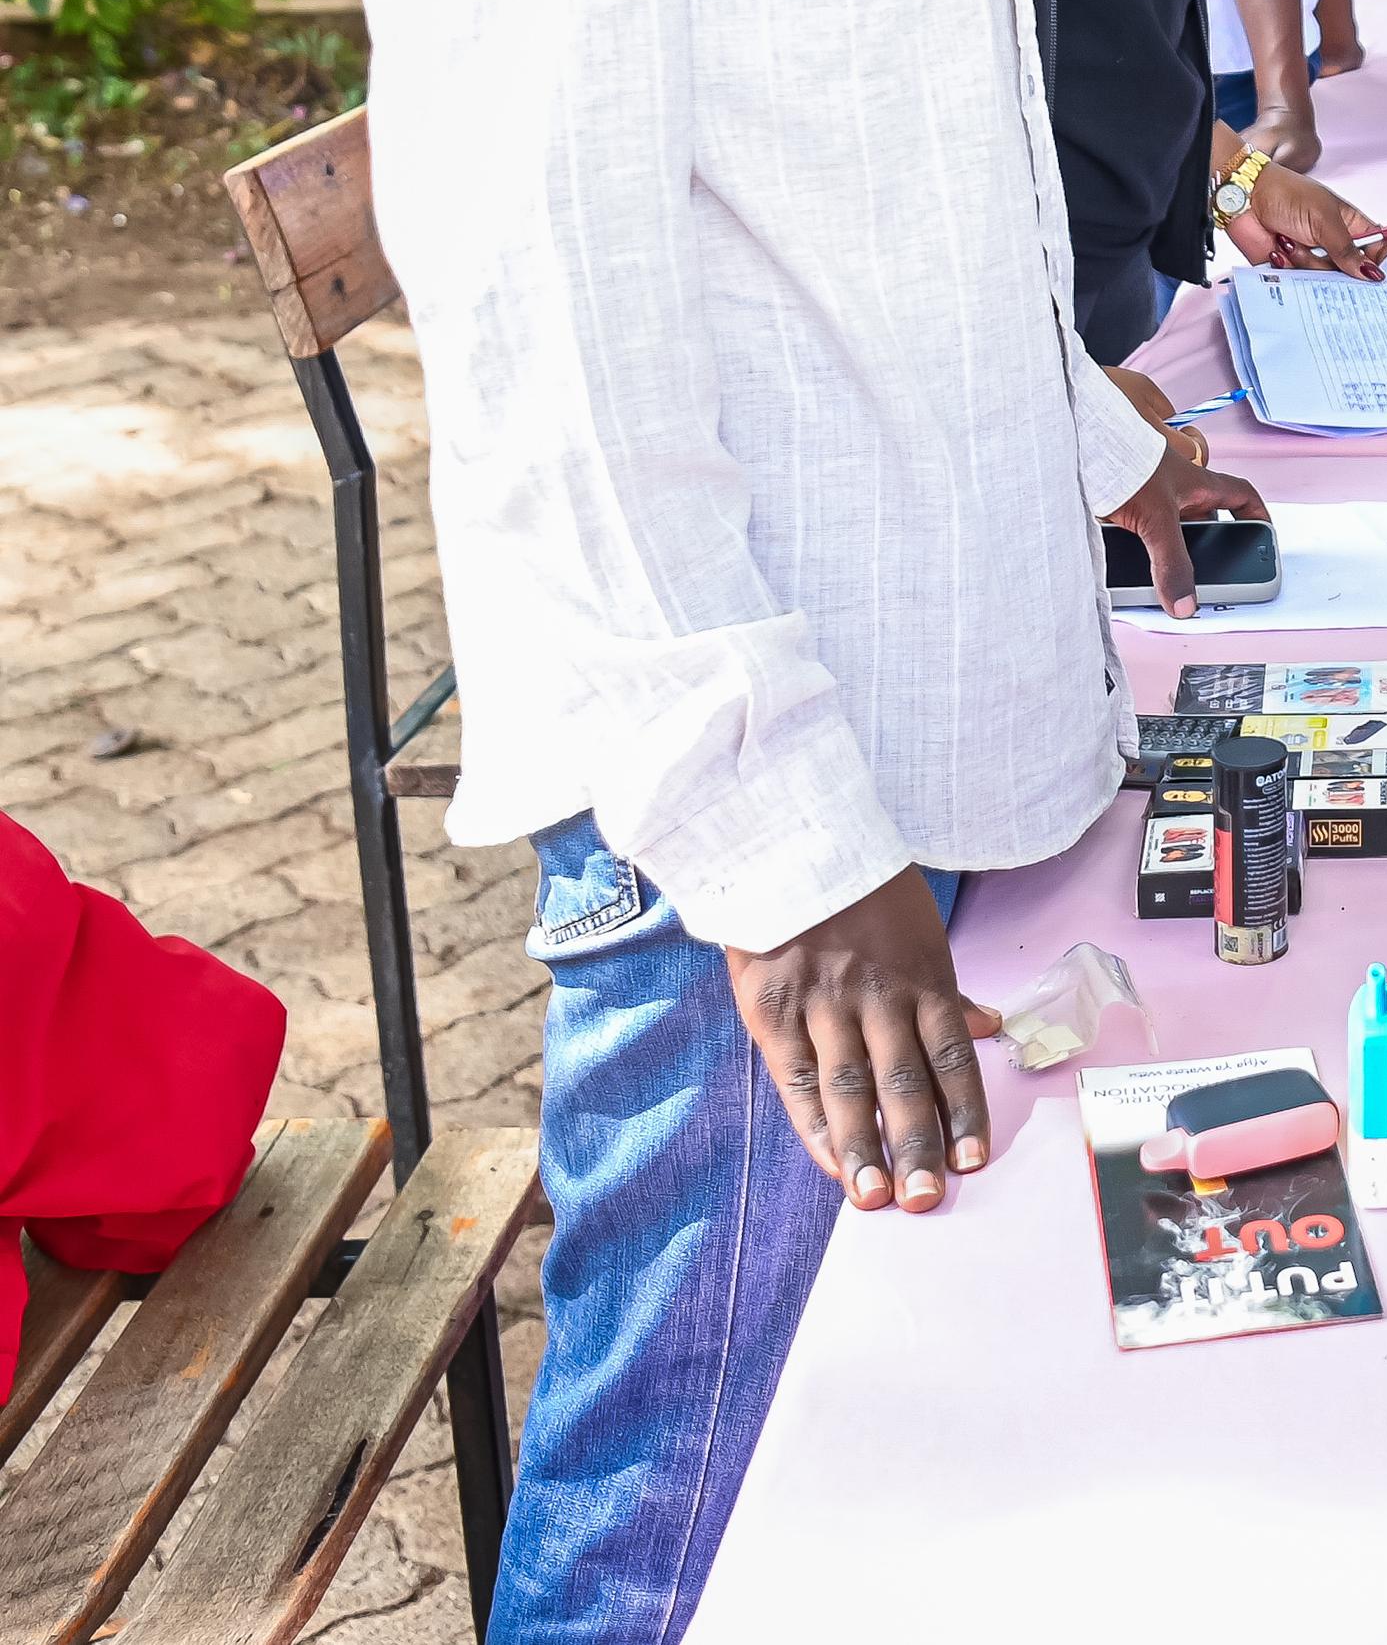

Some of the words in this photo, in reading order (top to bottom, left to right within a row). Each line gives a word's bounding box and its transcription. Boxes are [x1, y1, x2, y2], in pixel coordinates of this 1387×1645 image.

[1332, 823, 1359, 835] 3000
[1332, 834, 1359, 844] Puffs
[1194, 1213, 1346, 1262] OUT
